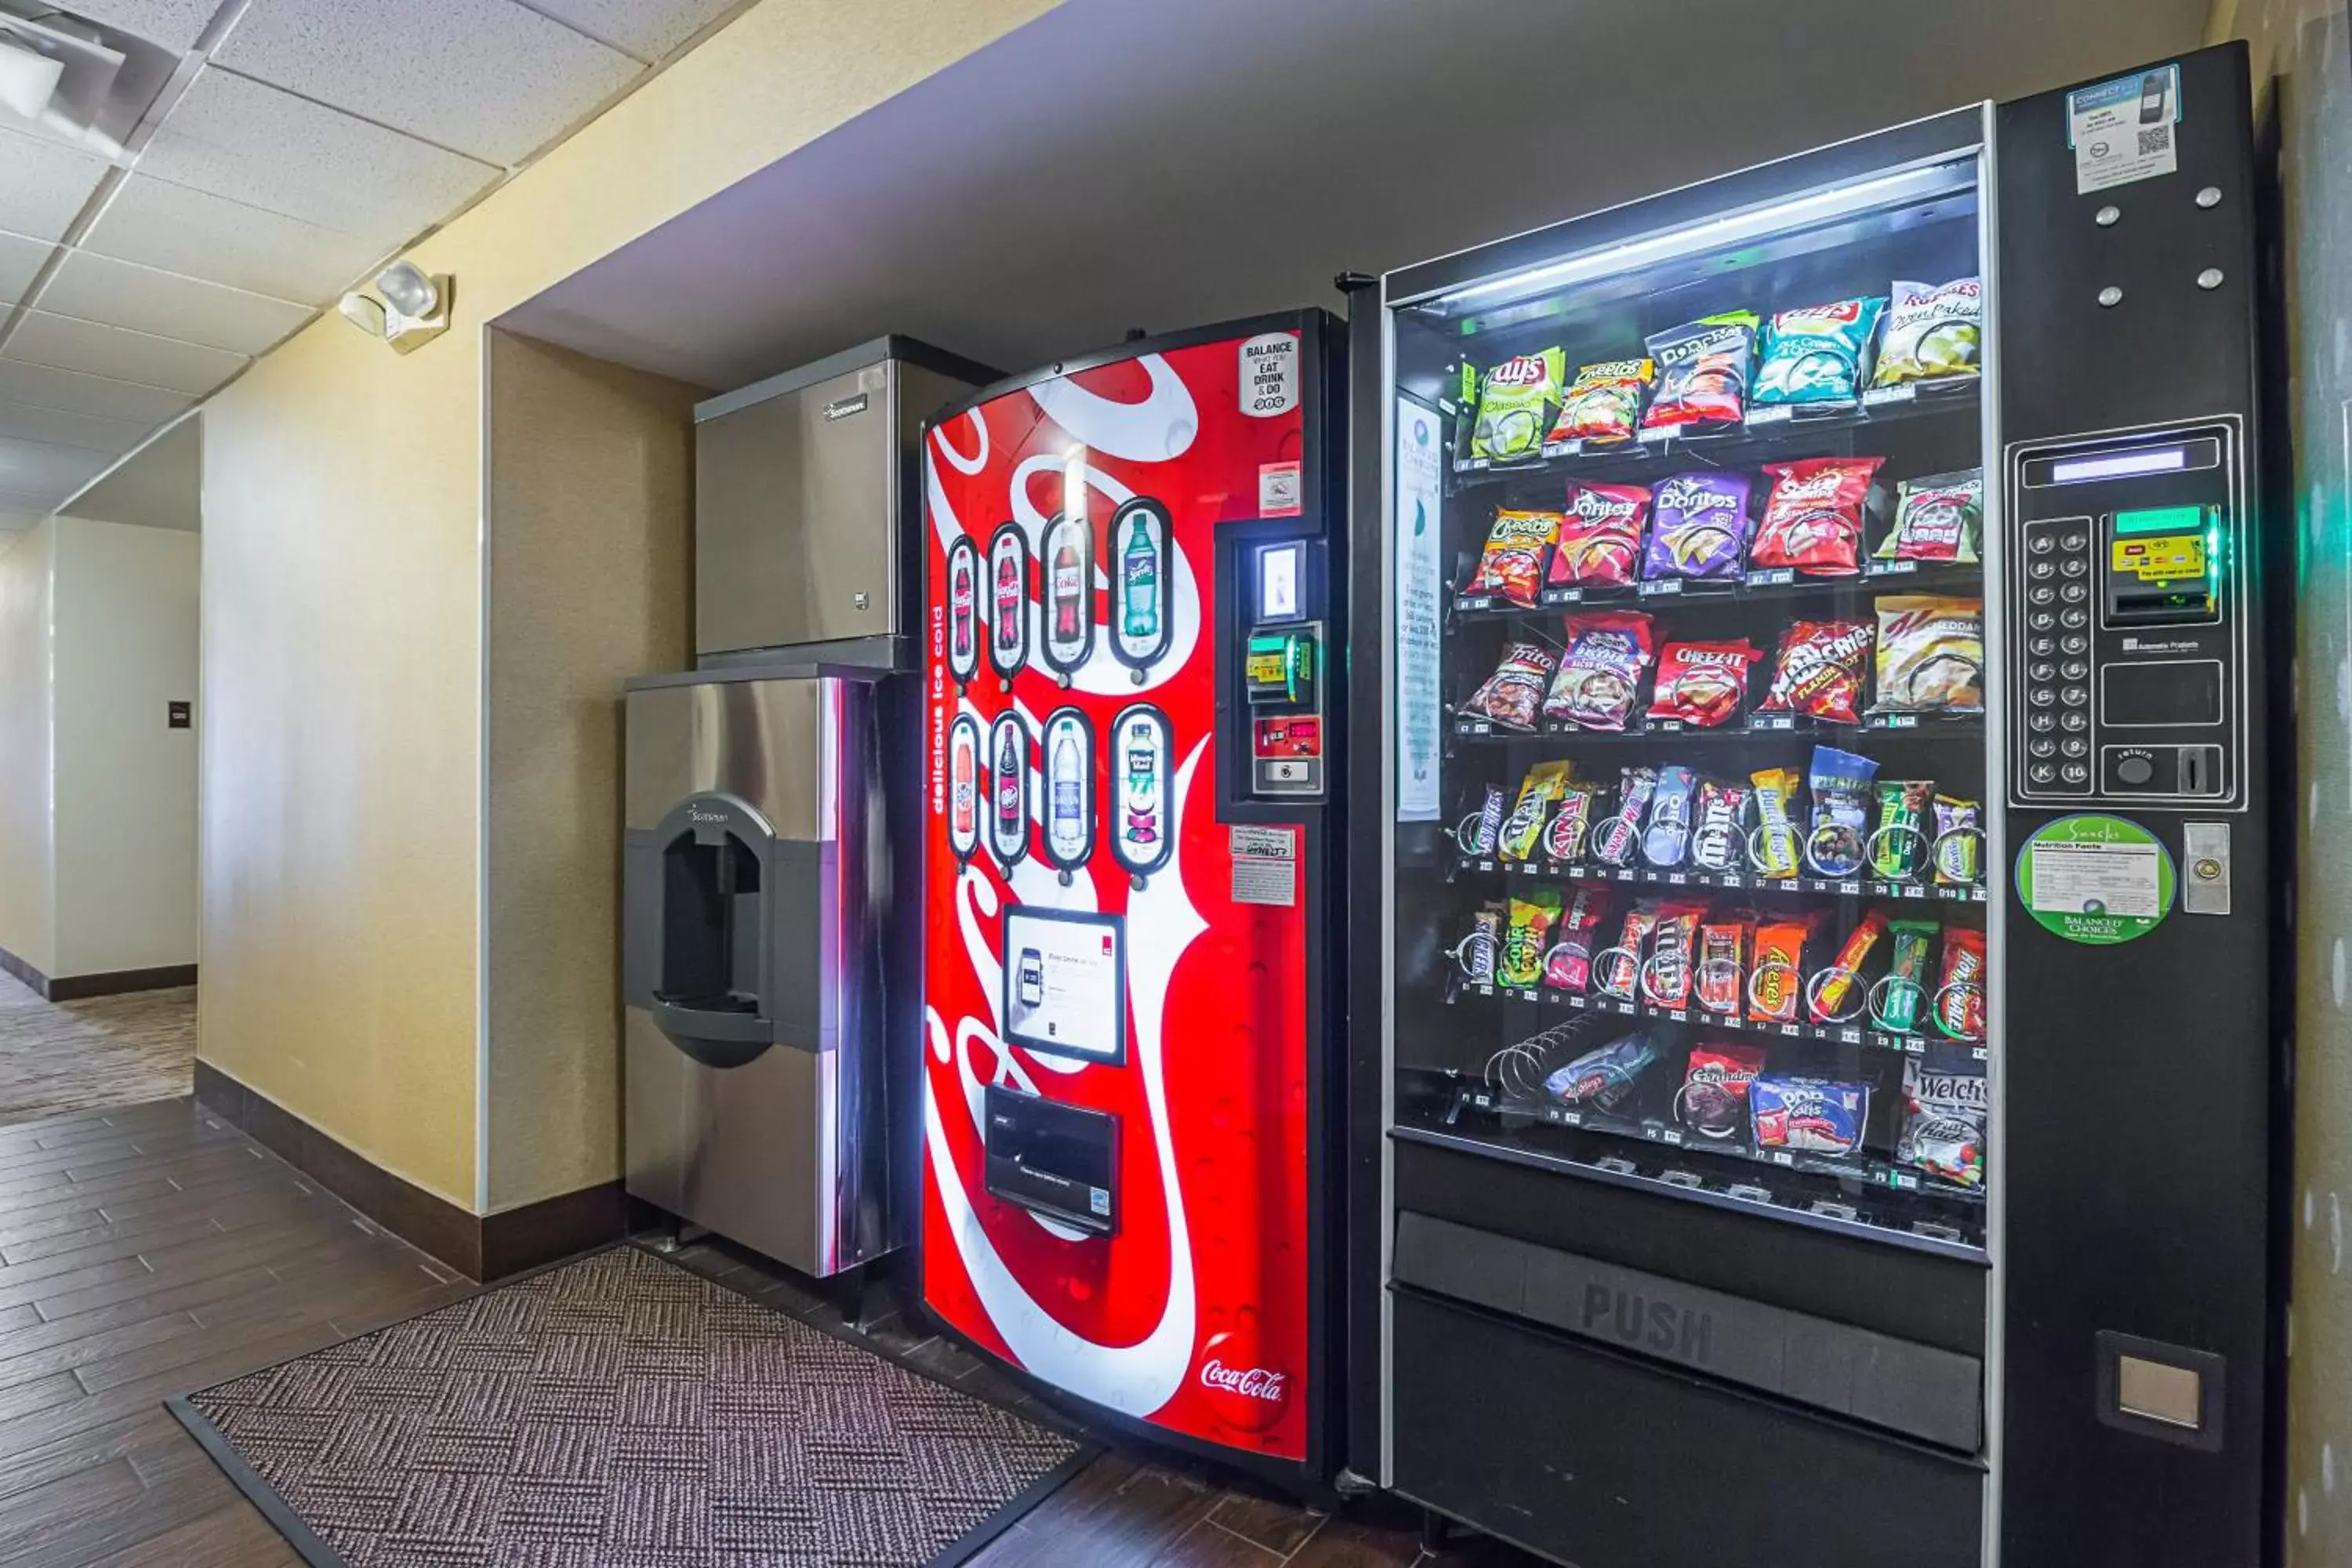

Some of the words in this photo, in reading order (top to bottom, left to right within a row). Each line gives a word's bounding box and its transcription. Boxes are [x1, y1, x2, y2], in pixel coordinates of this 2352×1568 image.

[1247, 342, 1293, 358] BALANCE
[1260, 362, 1278, 374] EAT
[1254, 372, 1284, 386] DRINK
[1266, 383, 1280, 394] DO
[1657, 492, 1737, 510] Doritos
[2038, 539, 2047, 548] A
[2038, 564, 2048, 573] B
[2070, 561, 2079, 571] 2
[2038, 588, 2048, 598] C
[2038, 615, 2048, 624] D
[933, 606, 944, 658] cold
[2038, 640, 2048, 649] E
[2071, 639, 2079, 648] 5
[2038, 665, 2047, 674] F
[2071, 665, 2079, 674] 6
[933, 665, 944, 698] ice
[2038, 691, 2048, 700] G
[2071, 690, 2079, 699] 7
[2038, 716, 2049, 725] H
[2071, 716, 2079, 724] 8
[2039, 742, 2048, 750] J
[2071, 741, 2079, 751] 9
[933, 706, 944, 813] delicious
[2038, 767, 2049, 776] K
[2068, 767, 2083, 777] 10
[1938, 887, 1956, 898] D10
[2063, 916, 2124, 927] BALANCED
[2068, 925, 2118, 935] CHOICES
[1583, 1283, 1713, 1363] PUSH
[1201, 1359, 1286, 1401] Coca-Cola
